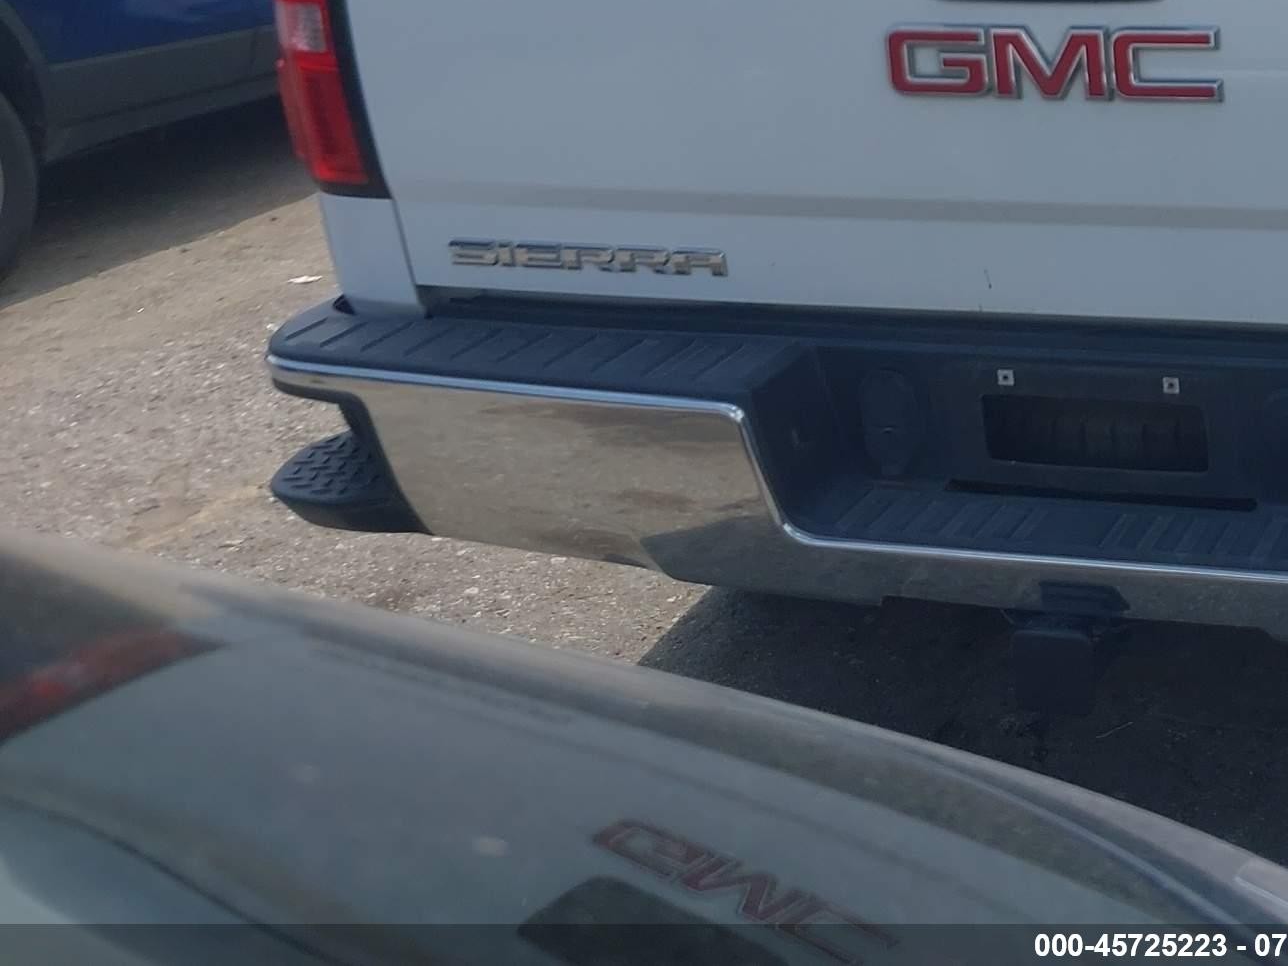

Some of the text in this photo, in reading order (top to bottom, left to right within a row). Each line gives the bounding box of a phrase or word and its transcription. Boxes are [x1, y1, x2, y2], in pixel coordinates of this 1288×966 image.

[887, 24, 1223, 102] GMC
[449, 238, 728, 277] SIERRA
[592, 818, 900, 965] GMC
